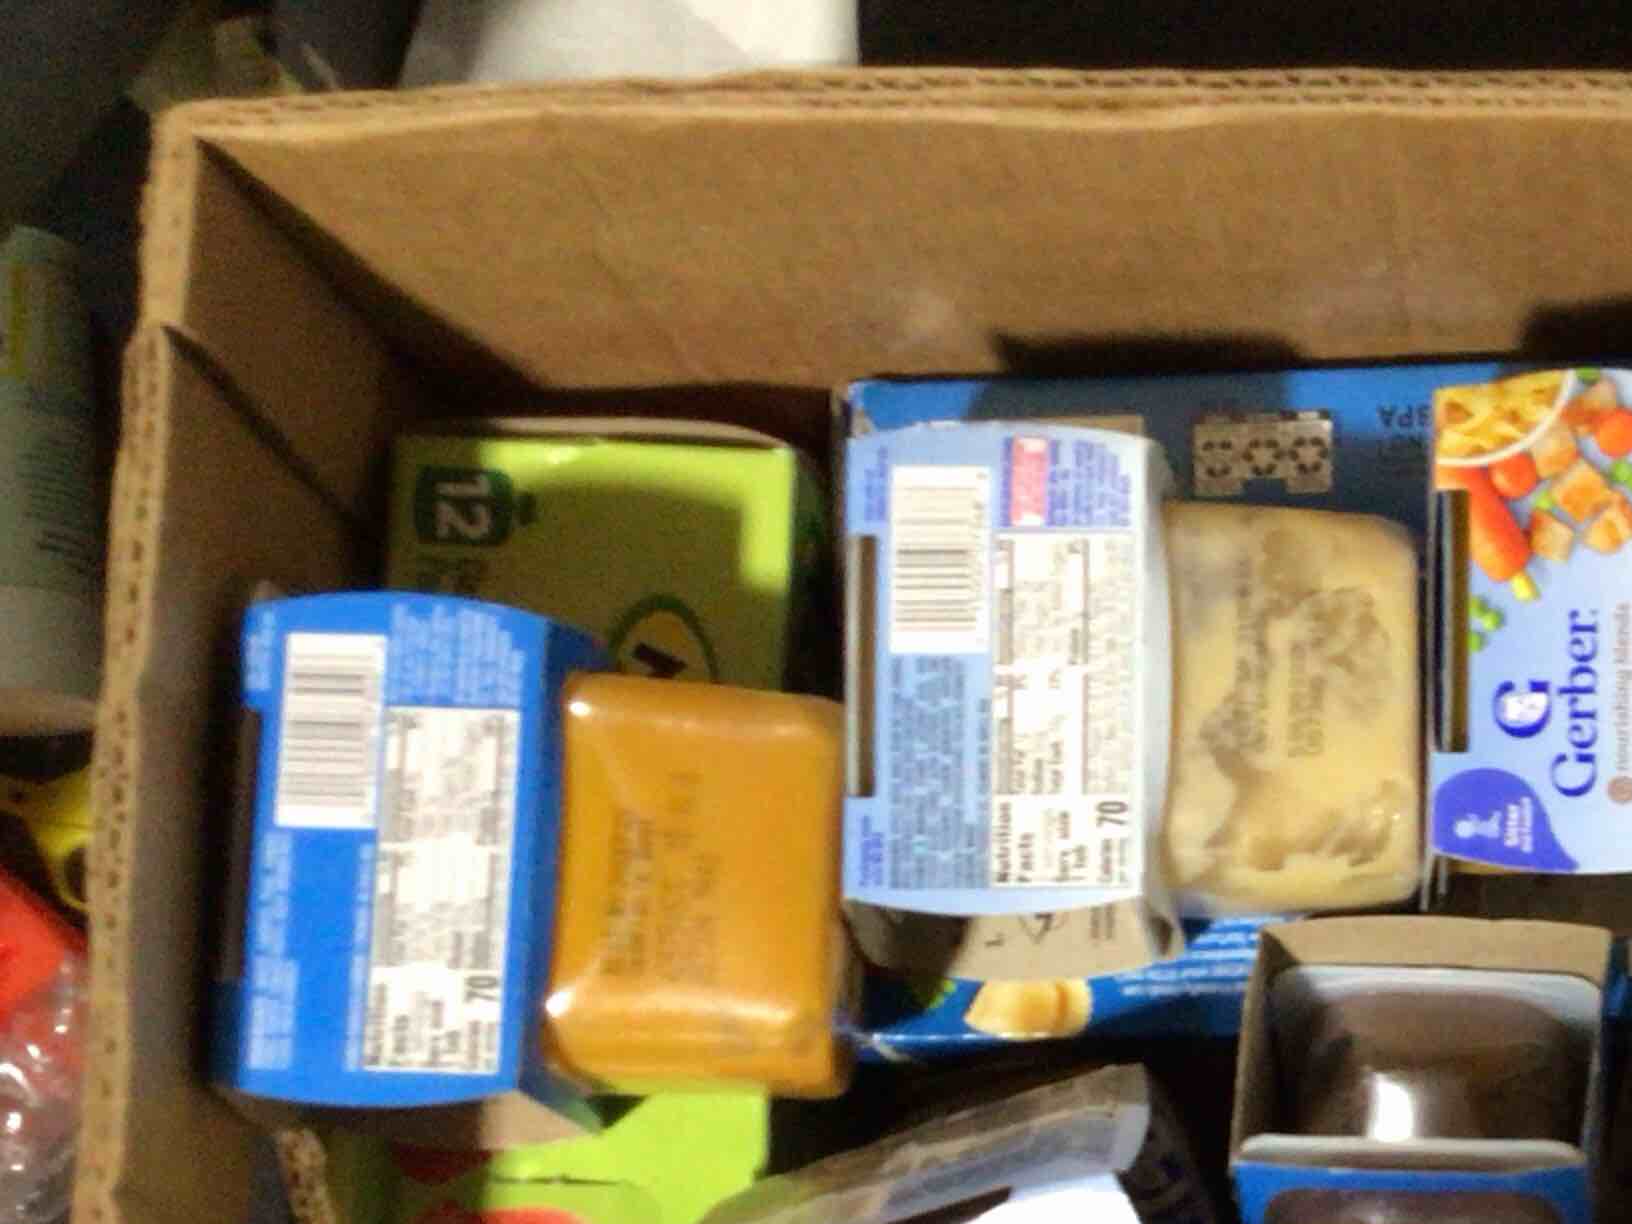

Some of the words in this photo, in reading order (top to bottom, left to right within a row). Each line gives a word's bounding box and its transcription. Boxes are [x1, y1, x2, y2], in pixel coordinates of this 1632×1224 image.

[433, 473, 491, 542] 12
[1611, 601, 1631, 665] blends
[1550, 611, 1600, 798] Gerber
[1609, 669, 1632, 771] nourishing
[1096, 801, 1128, 828] 70
[465, 974, 498, 1003] 70
